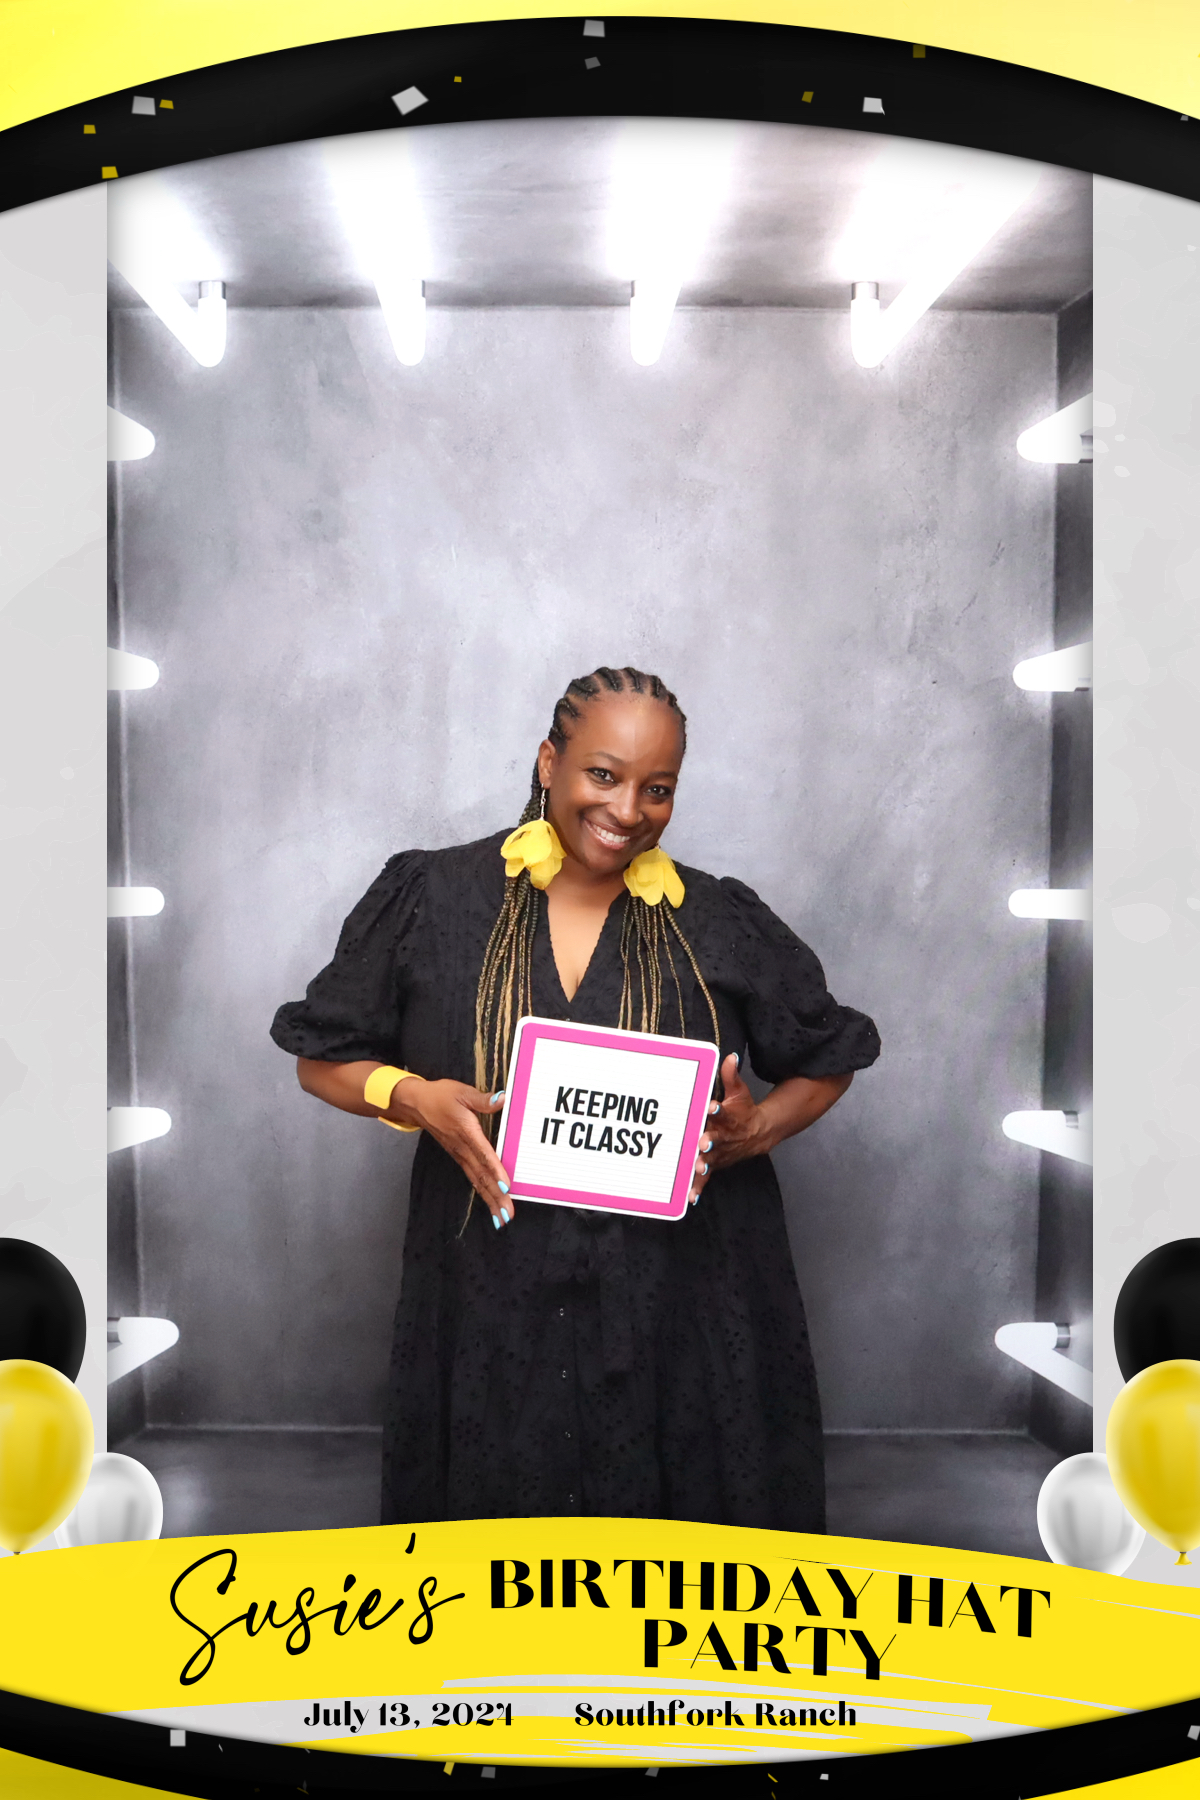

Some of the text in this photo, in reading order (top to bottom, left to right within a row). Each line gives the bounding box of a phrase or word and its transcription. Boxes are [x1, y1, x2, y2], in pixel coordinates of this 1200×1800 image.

[554, 1085, 660, 1126] KEEPING
[540, 1117, 663, 1159] IT CLASSY
